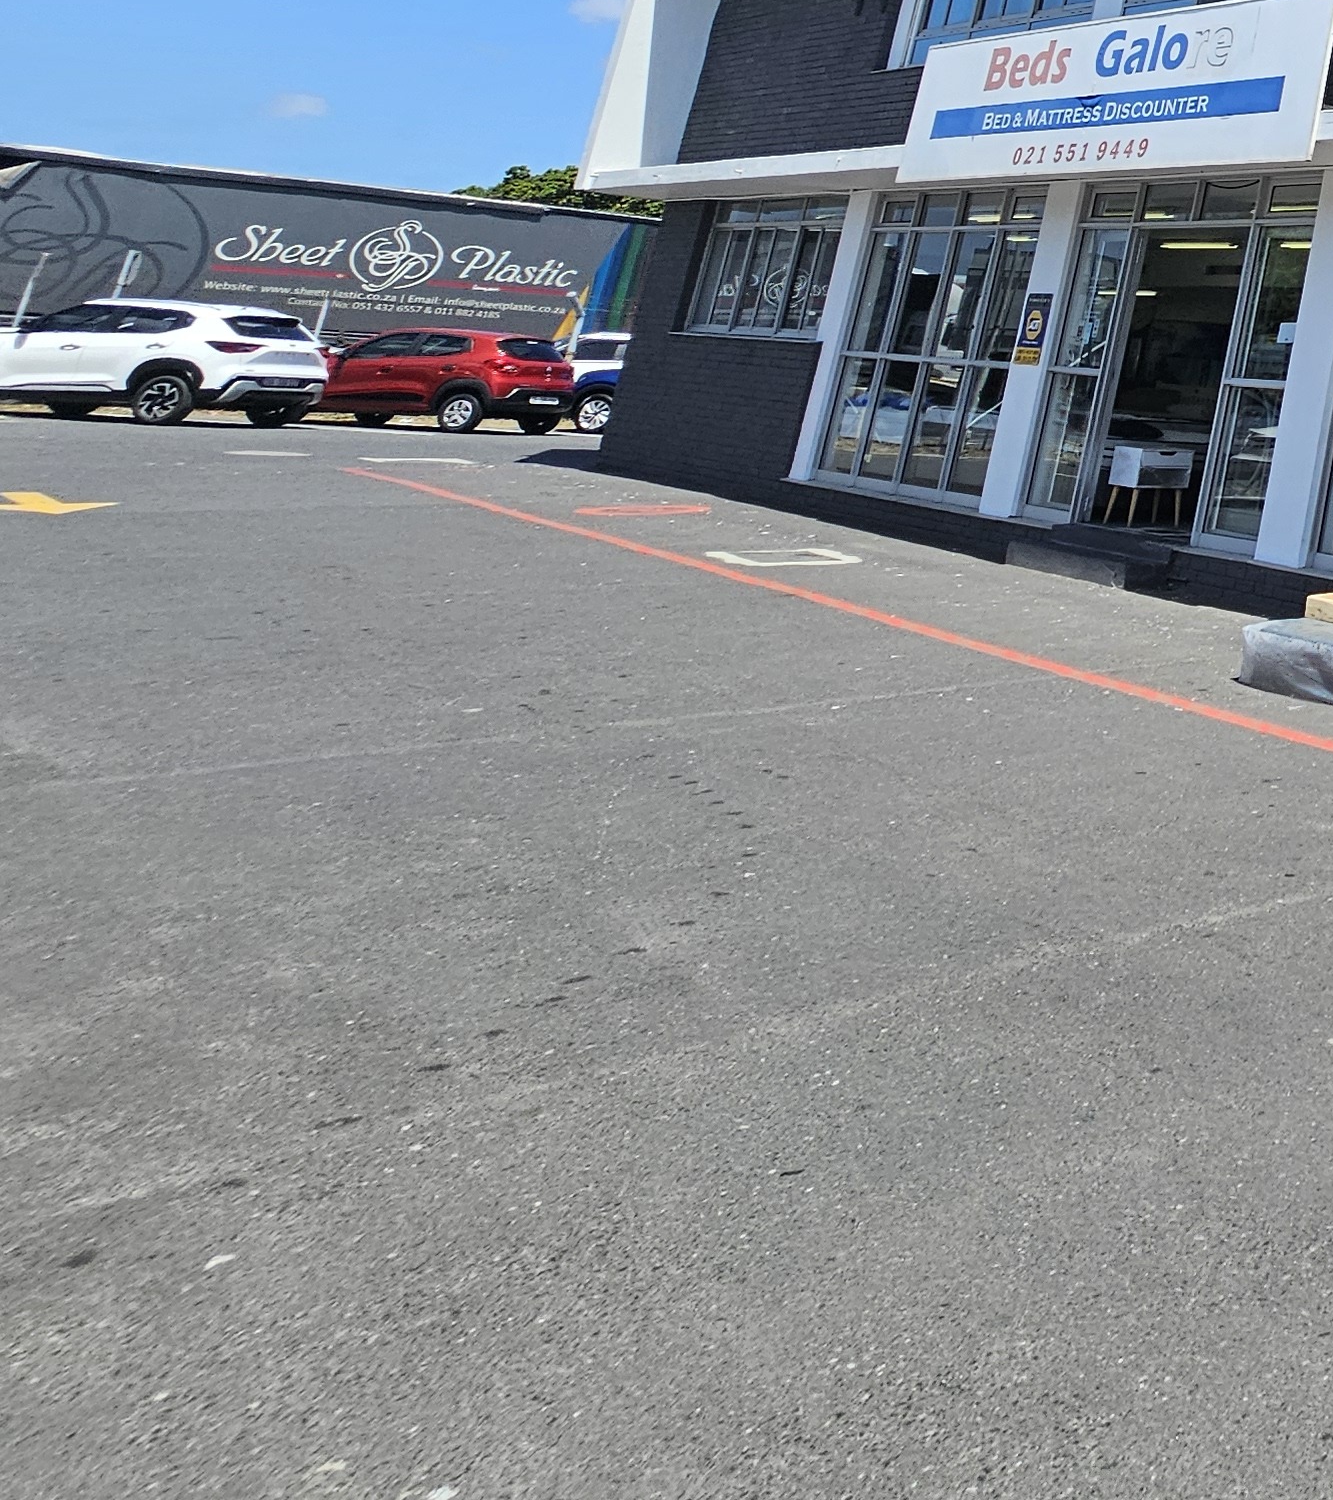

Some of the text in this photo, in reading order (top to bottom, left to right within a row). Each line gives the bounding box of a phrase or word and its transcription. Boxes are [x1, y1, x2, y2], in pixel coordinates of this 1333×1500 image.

[983, 40, 1072, 91] Beds
[982, 95, 1209, 130] BED & MATTRESS DISCOUNTER
[1012, 138, 1149, 166] 021 551 9449
[214, 224, 347, 267] Sheet
[451, 245, 578, 288] Plastic
[203, 280, 257, 293] Website:
[260, 286, 397, 303] www.sheetlastic.co.za
[407, 295, 442, 305] Email:
